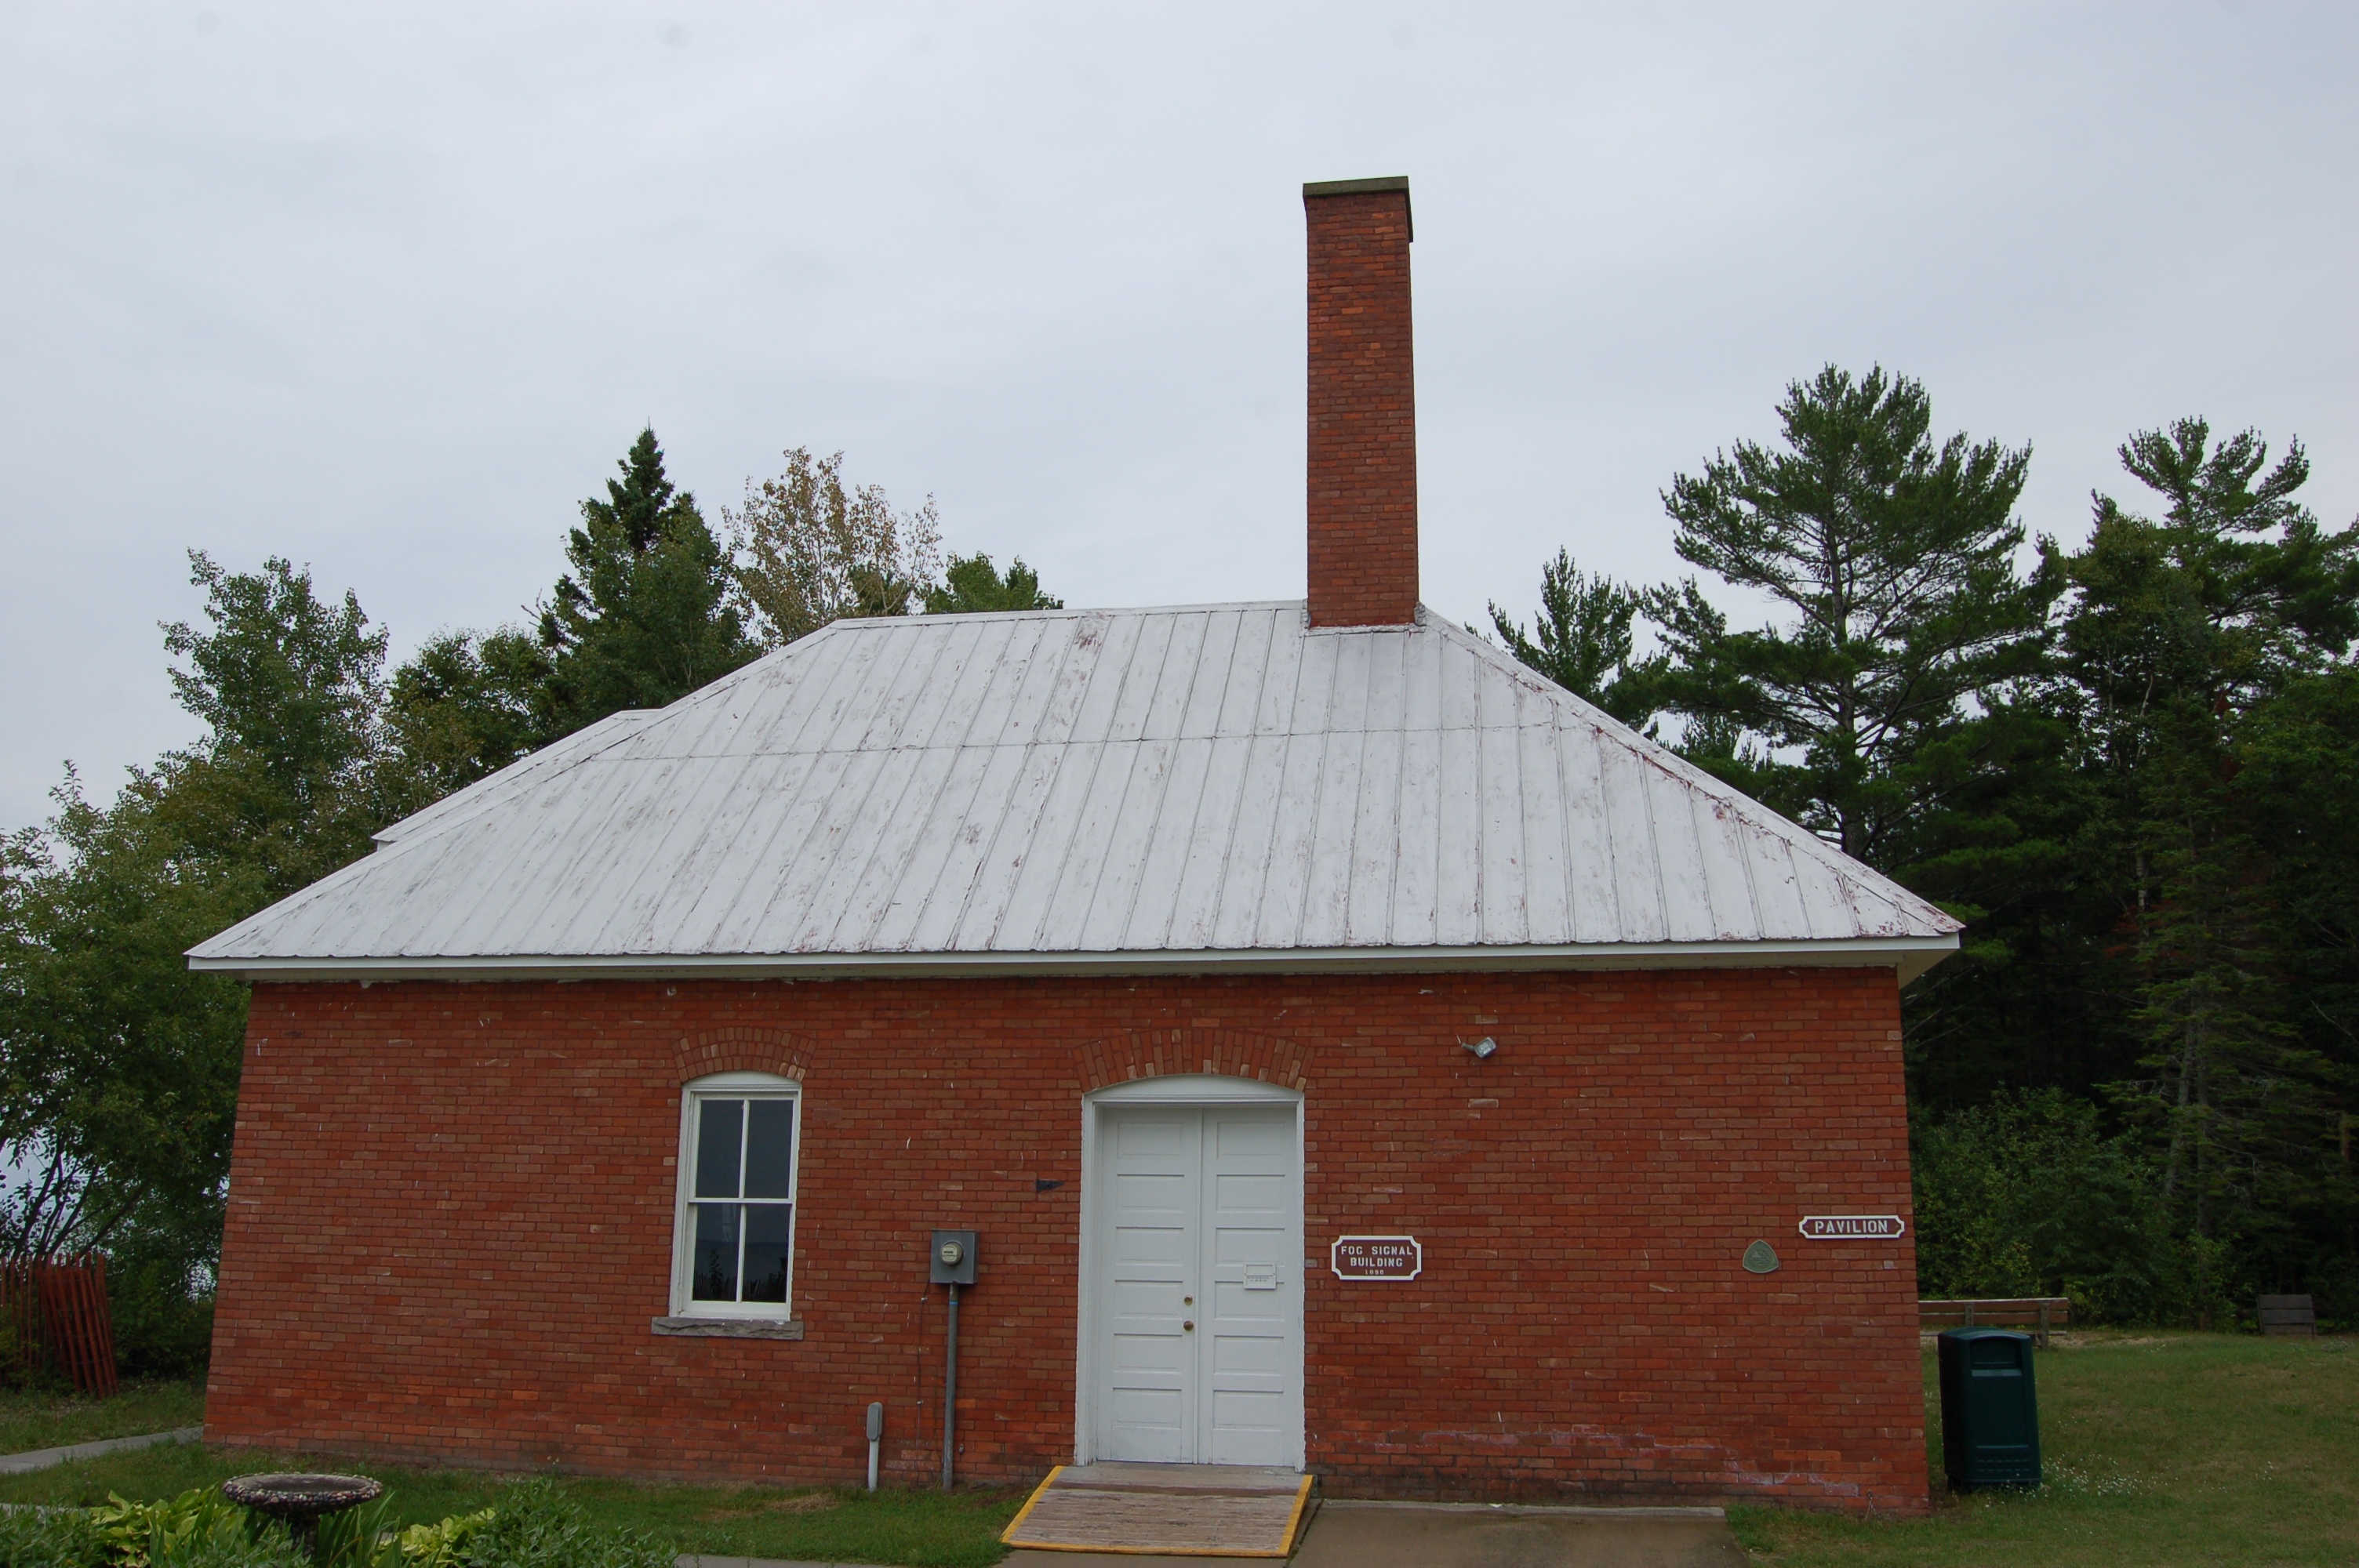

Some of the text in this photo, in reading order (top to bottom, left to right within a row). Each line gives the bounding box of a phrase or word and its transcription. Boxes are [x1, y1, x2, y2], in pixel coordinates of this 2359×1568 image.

[1815, 1220, 1888, 1233] PAVILION
[1341, 1246, 1412, 1255] FOG SIGNAL
[1350, 1258, 1403, 1267] BUILDING
